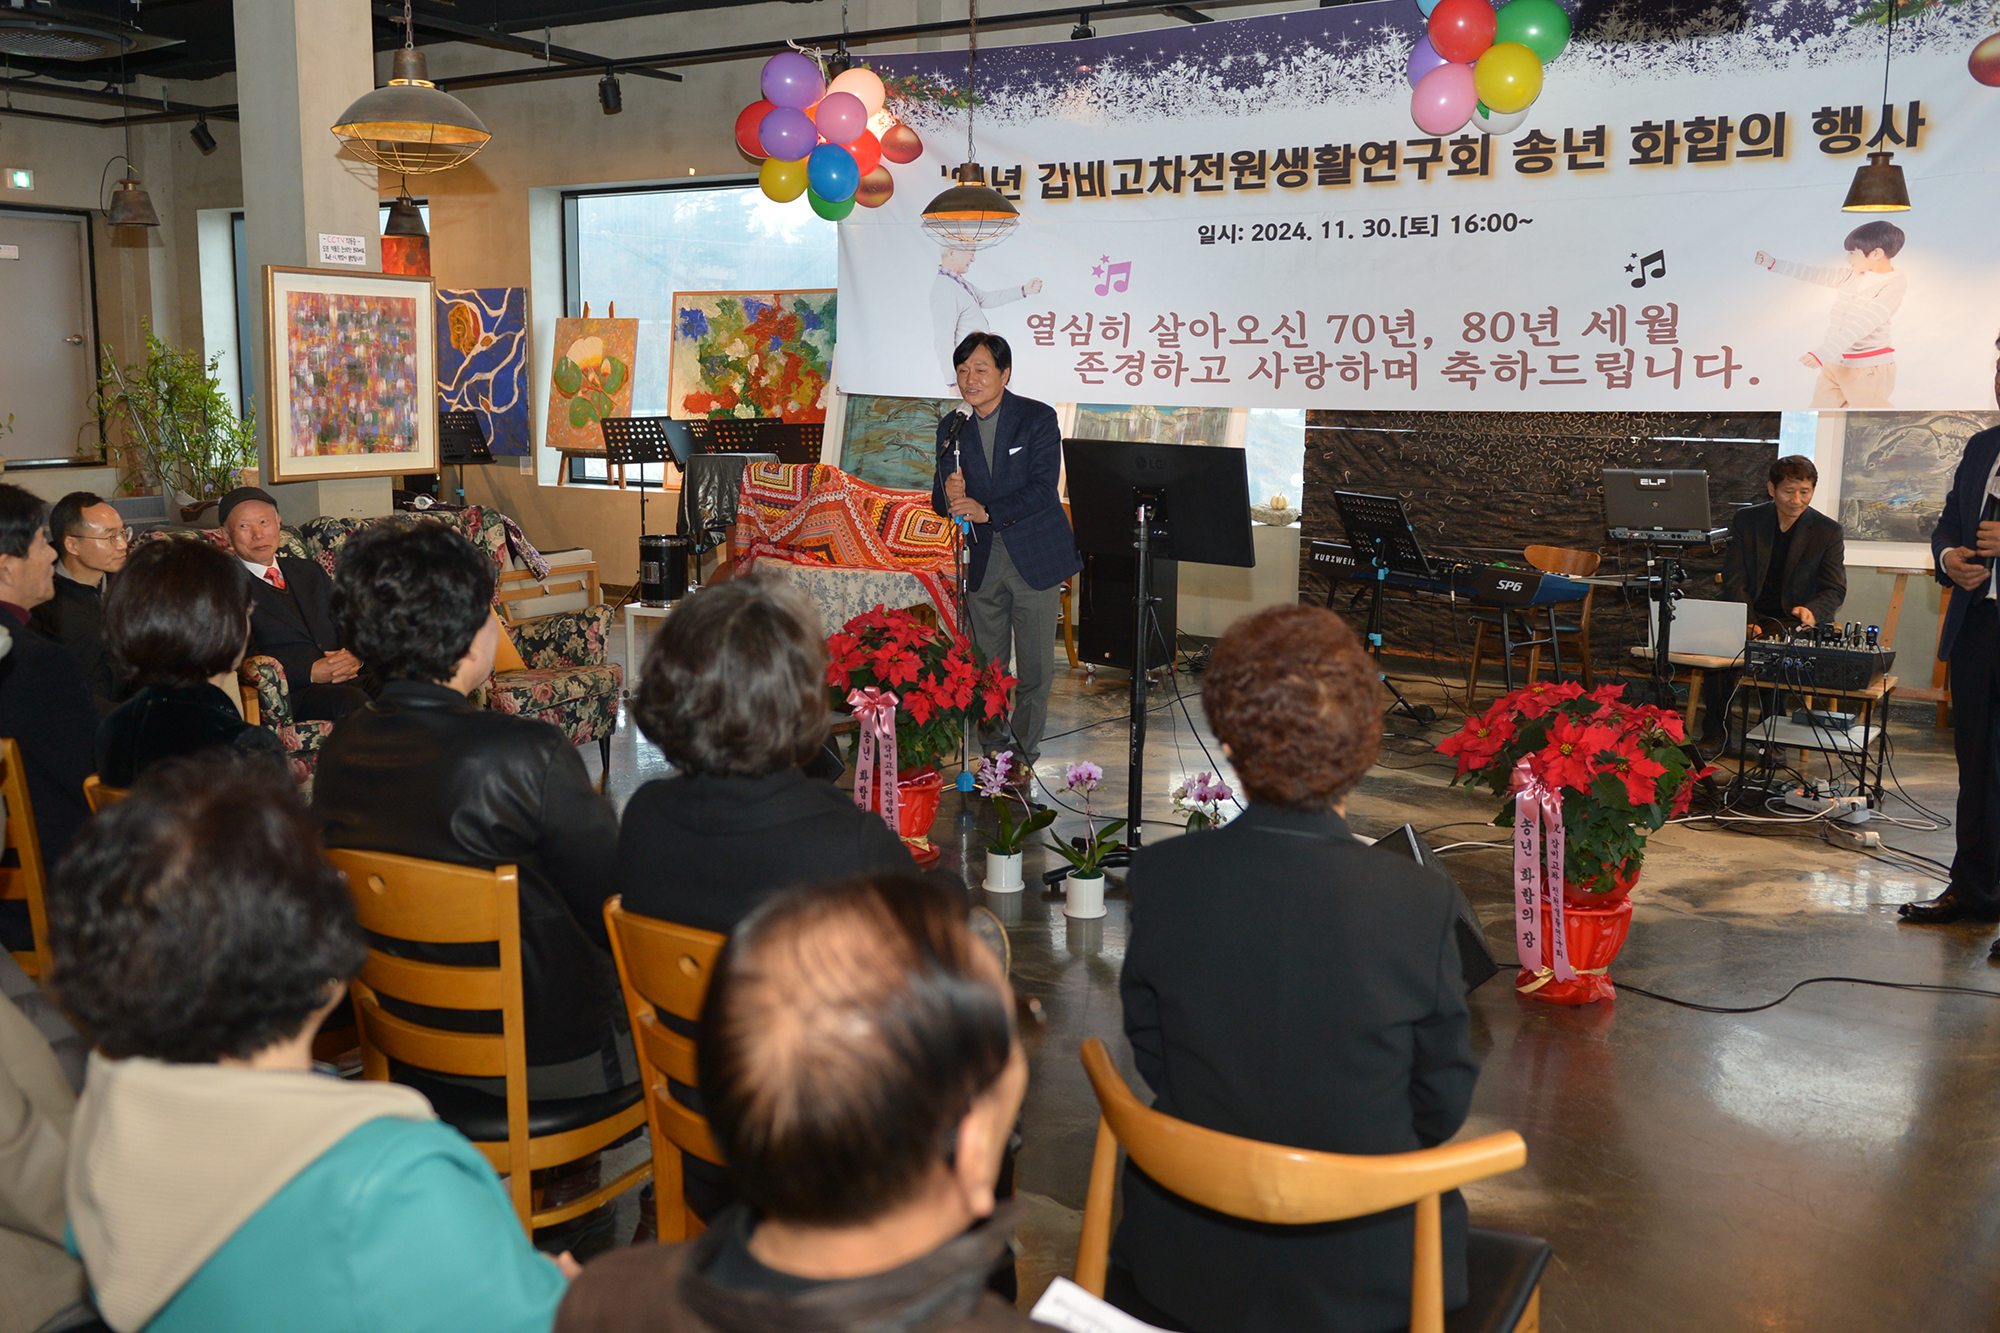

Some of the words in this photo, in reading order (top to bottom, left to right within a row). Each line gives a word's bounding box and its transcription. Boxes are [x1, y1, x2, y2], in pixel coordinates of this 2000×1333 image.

[941, 164, 1022, 200] '년
[1038, 132, 1491, 200] 갑비고차전원생활연구회
[1512, 124, 1606, 173] 송년
[1629, 111, 1786, 165] 화합의
[1812, 100, 1925, 154] 행사
[1197, 224, 1244, 245] 일시:
[1251, 222, 1313, 242] 2024.
[1321, 220, 1354, 240] 11.
[1362, 214, 1439, 239] 30.[토]
[1450, 212, 1534, 234] 16:00~
[1026, 311, 1131, 348] 열심히
[1149, 310, 1308, 349] 살아오신
[1326, 308, 1434, 350] 70년,
[1462, 306, 1560, 347] 80년
[1581, 302, 1680, 346] 세월
[1073, 350, 1231, 388] 존경하고
[1247, 350, 1418, 390] 사랑하며
[1440, 345, 1761, 391] 축하드립니다.
[1314, 552, 1356, 567] KURZWEIL
[1496, 579, 1523, 592] SP6
[863, 730, 872, 761] 송년
[1520, 818, 1534, 857] 송년
[1520, 866, 1535, 925] 화합의
[1522, 930, 1536, 948] 장
